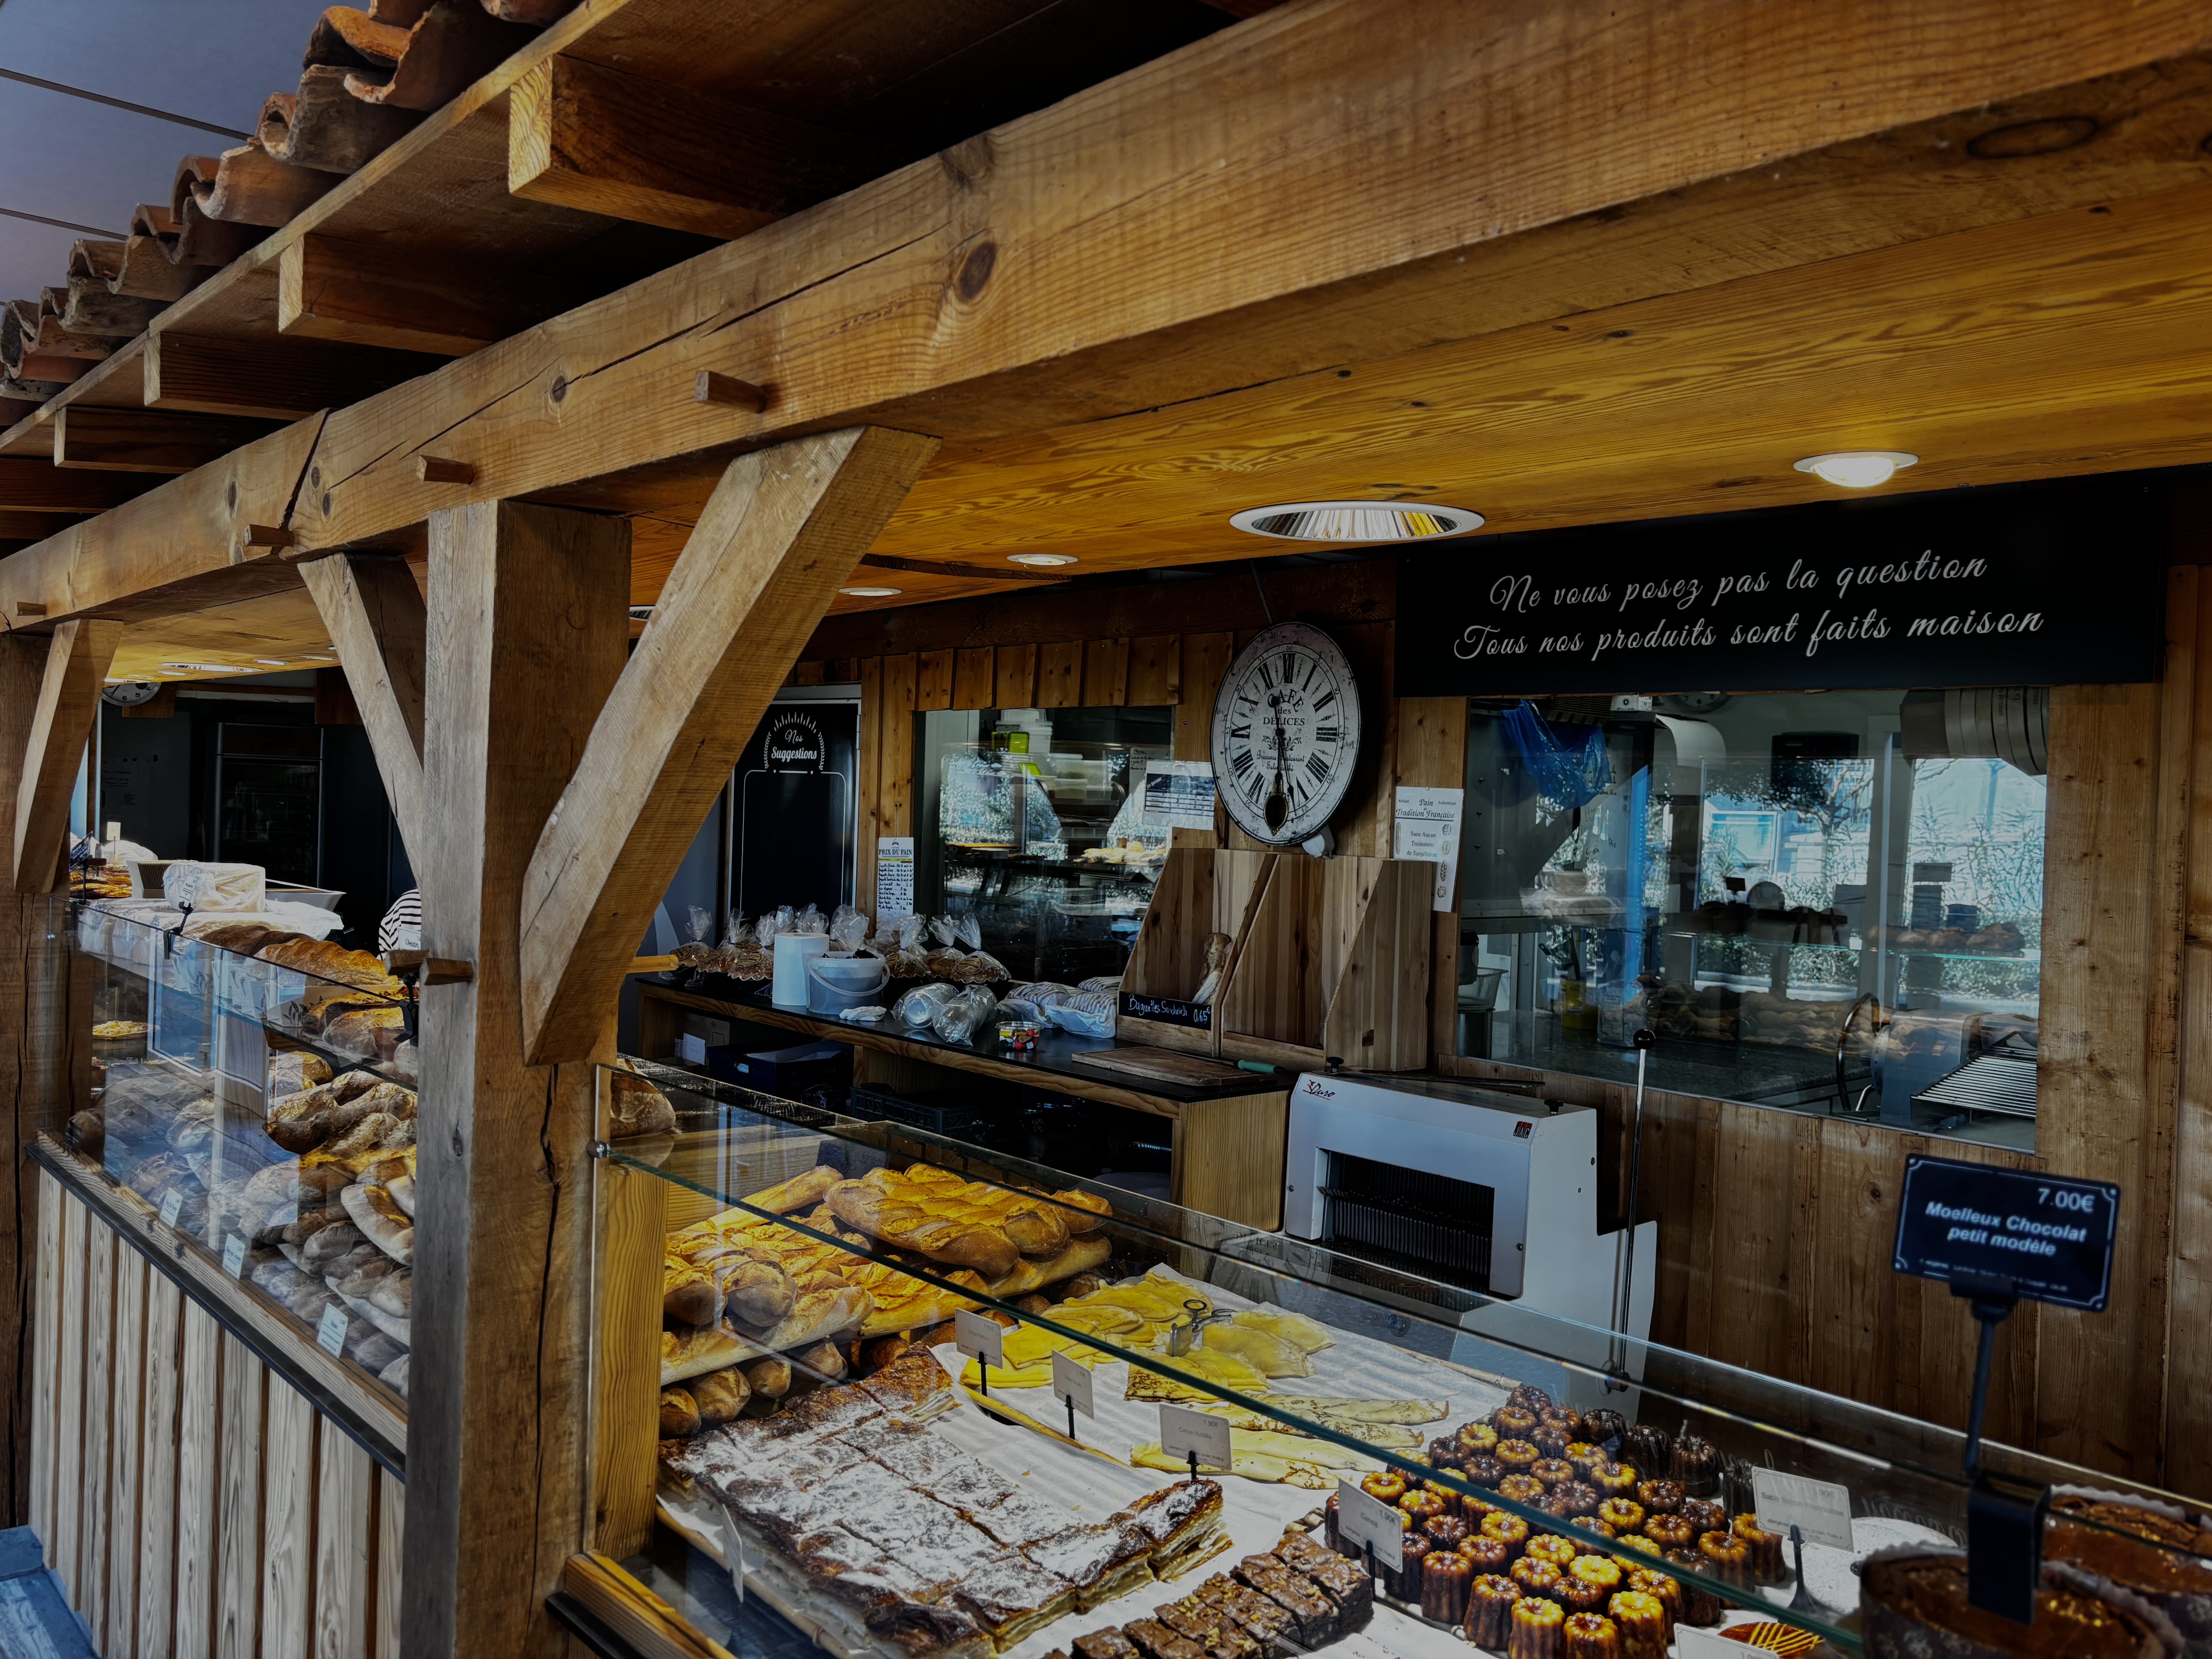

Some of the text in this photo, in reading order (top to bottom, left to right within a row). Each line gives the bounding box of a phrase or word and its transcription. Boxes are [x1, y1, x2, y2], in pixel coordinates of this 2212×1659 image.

[1489, 549, 1988, 613] Ne vous posez pas la question
[1454, 608, 2045, 661] Tous nos produits sont faits maison
[1263, 717, 1305, 726] DELICES
[785, 729, 804, 744] Nos
[771, 747, 817, 763] Suggestions
[1396, 809, 1455, 820] Tradition Française
[1128, 993, 1161, 1016] Baguettes
[1161, 1000, 1188, 1017] Sandwich
[1513, 1125, 1530, 1138] JAC
[2038, 1187, 2095, 1213] 7.00€
[1925, 1201, 2087, 1242] Moelleux Chocolat
[1947, 1226, 2056, 1256] petit modèle
[1379, 1509, 1396, 1526] 1.90€
